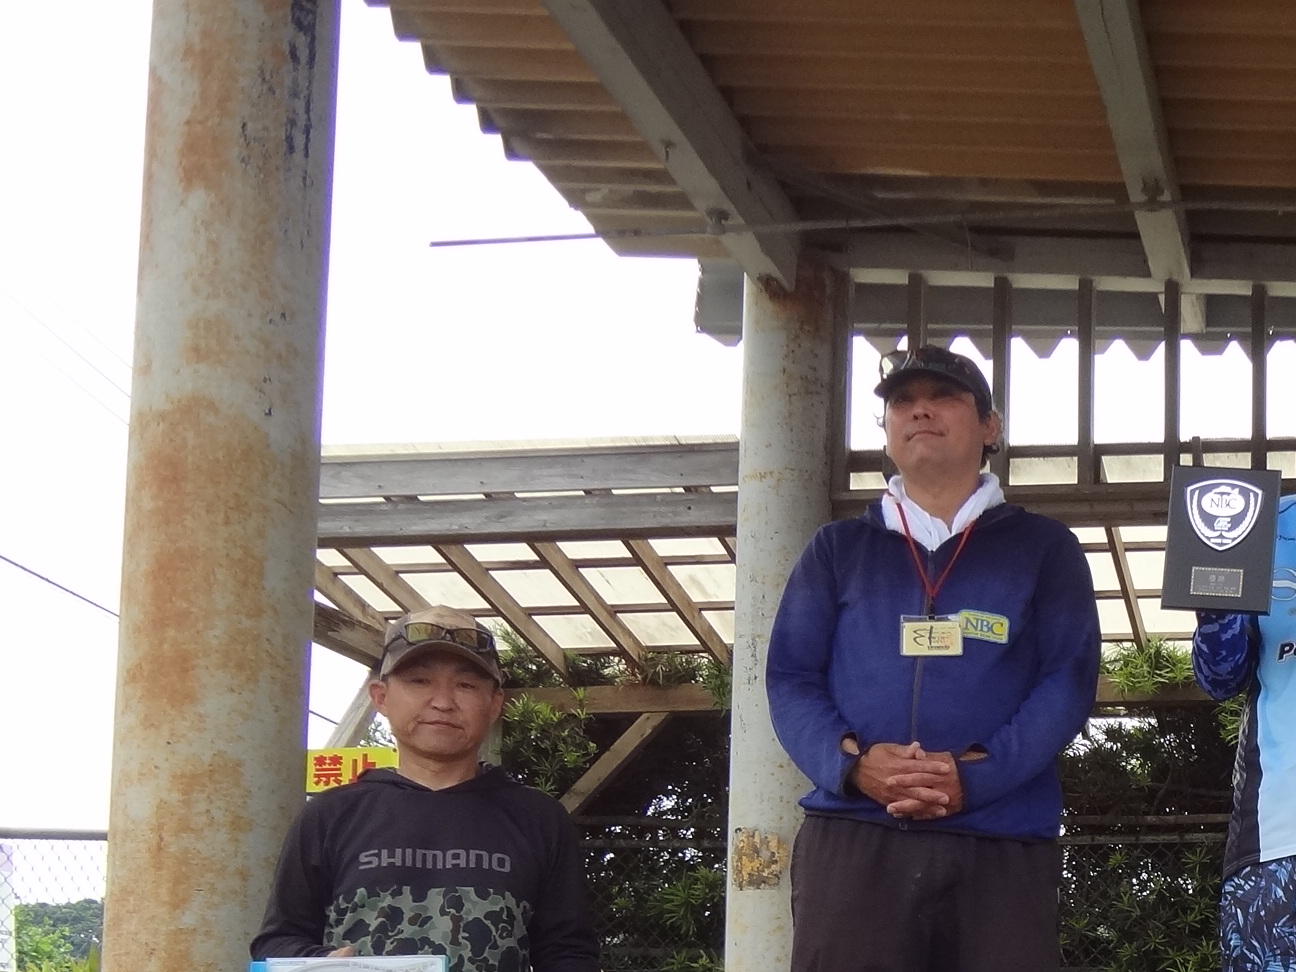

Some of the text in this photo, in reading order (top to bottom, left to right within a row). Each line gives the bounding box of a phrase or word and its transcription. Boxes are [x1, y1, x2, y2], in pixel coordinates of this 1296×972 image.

[1209, 497, 1237, 510] NBC
[963, 616, 1004, 636] NBC
[358, 848, 511, 873] SHIMANO
